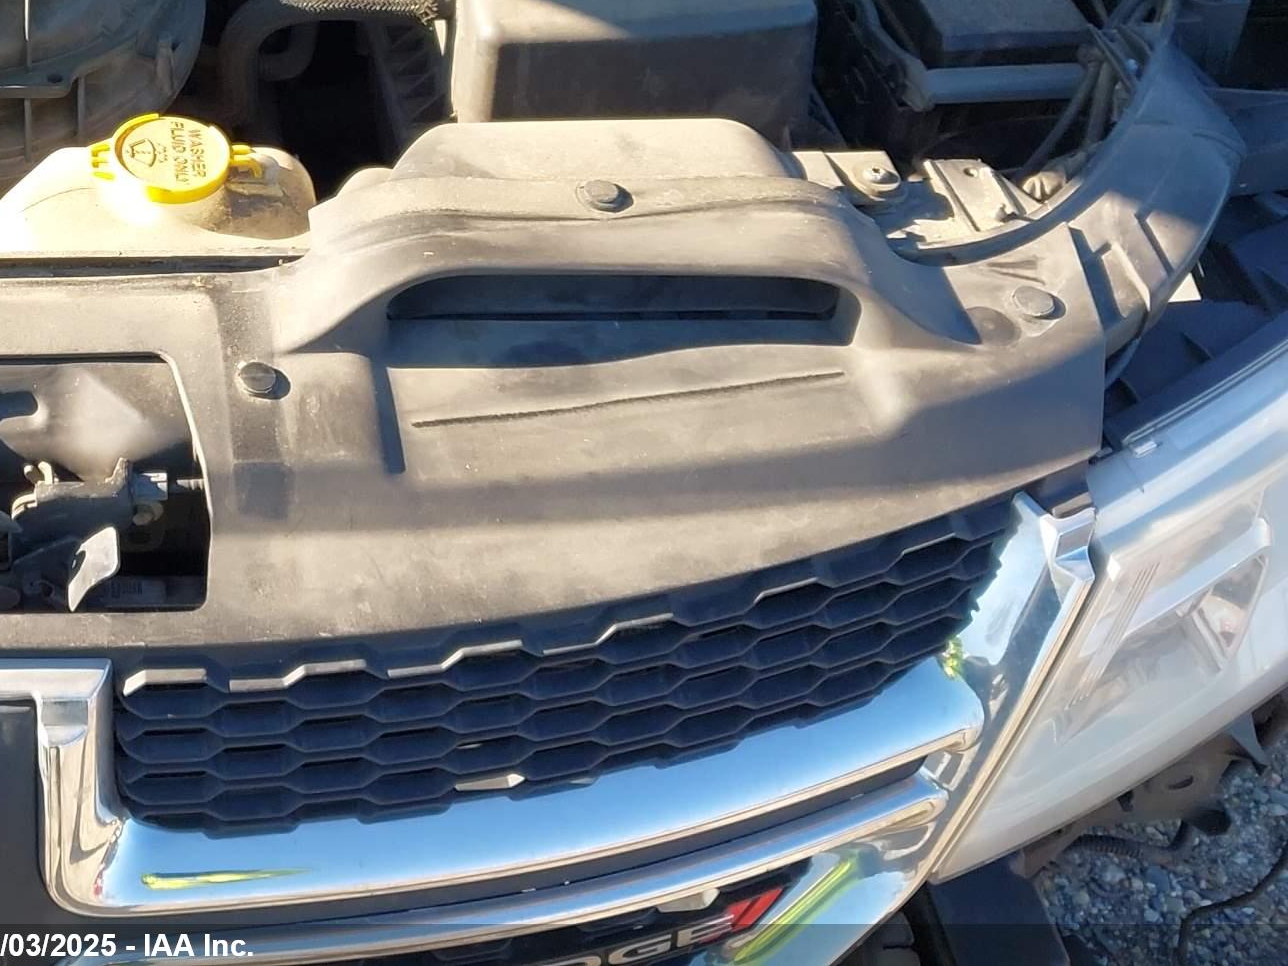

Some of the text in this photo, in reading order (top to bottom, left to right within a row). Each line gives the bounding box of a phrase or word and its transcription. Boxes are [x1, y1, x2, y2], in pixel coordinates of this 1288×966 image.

[170, 122, 190, 185] FLUID ONLY
[188, 130, 206, 178] WASHER
